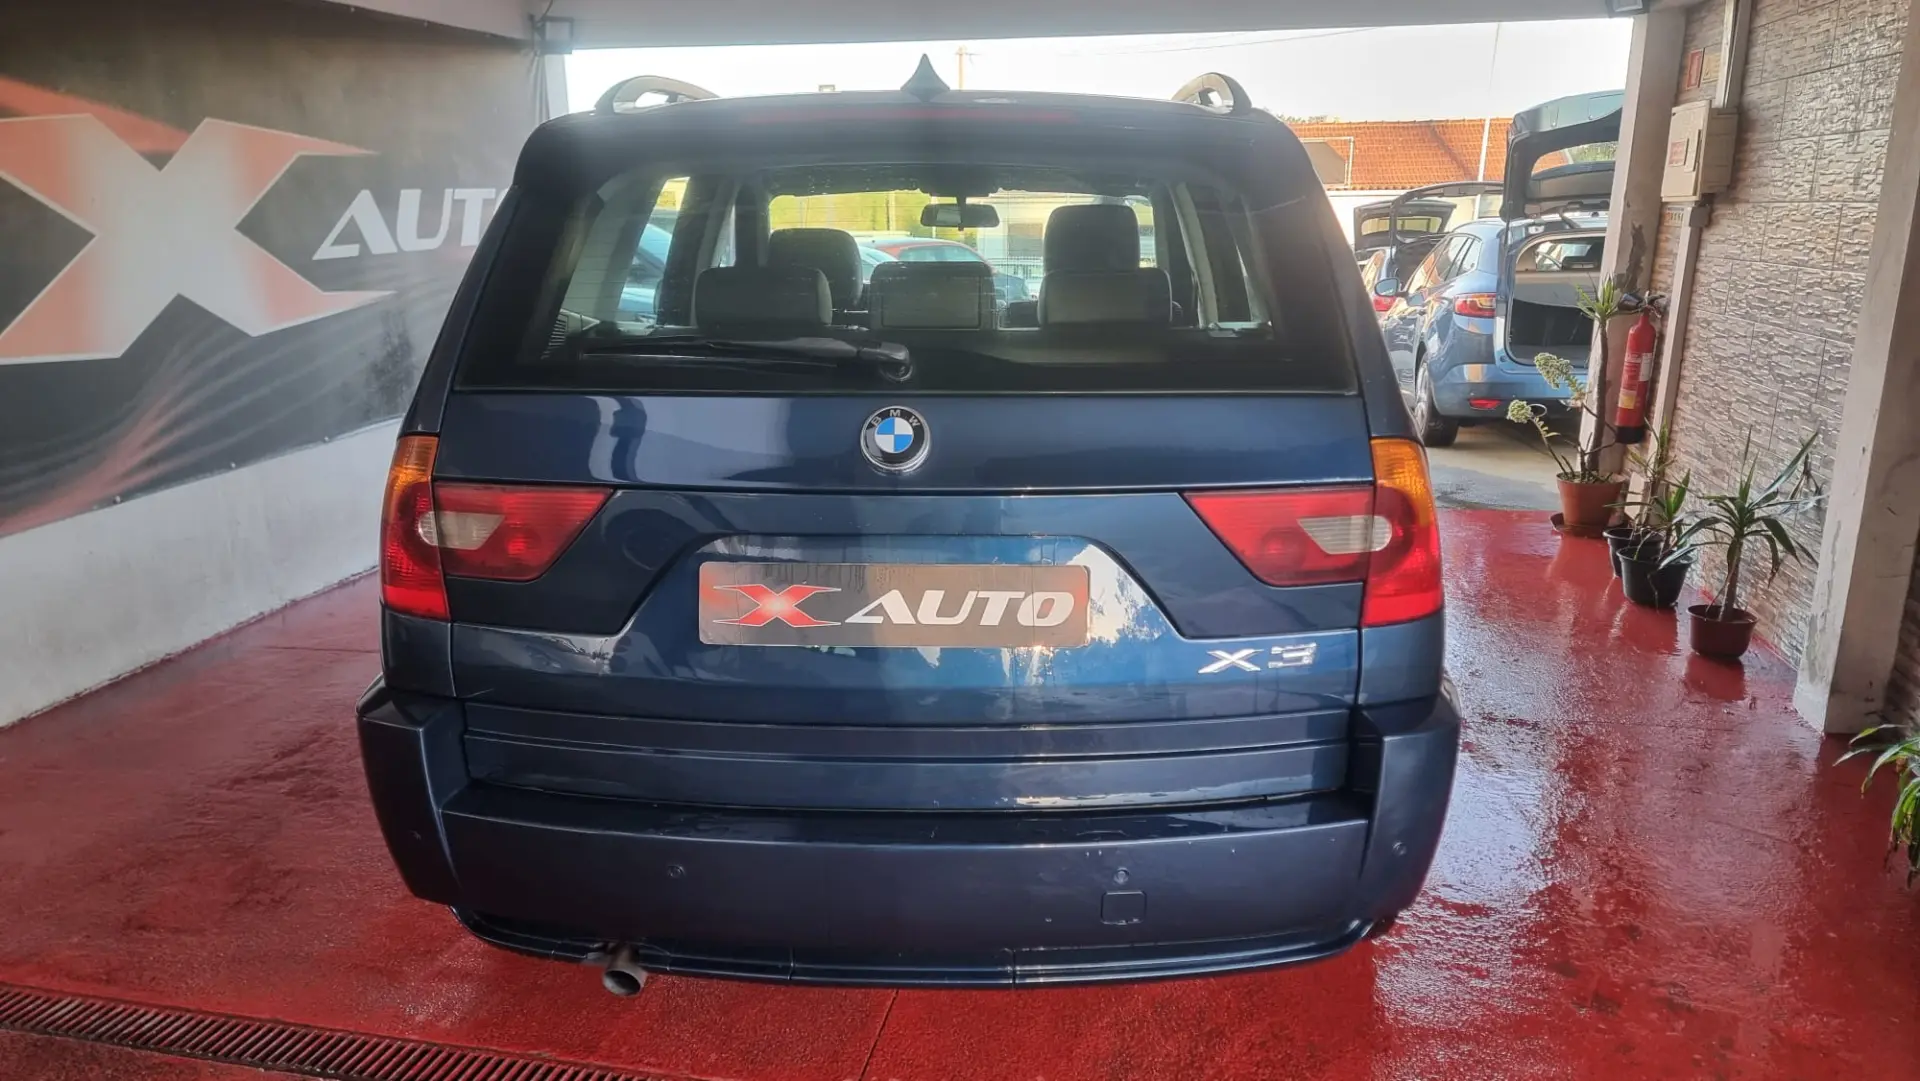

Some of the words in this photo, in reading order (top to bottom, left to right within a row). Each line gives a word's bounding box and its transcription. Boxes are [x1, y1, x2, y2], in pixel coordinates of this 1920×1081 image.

[0, 114, 397, 365] X
[312, 188, 511, 261] AUT
[870, 409, 921, 428] BMW
[713, 583, 842, 628] X
[844, 589, 1075, 627] AUTO
[1198, 642, 1317, 674] X3
